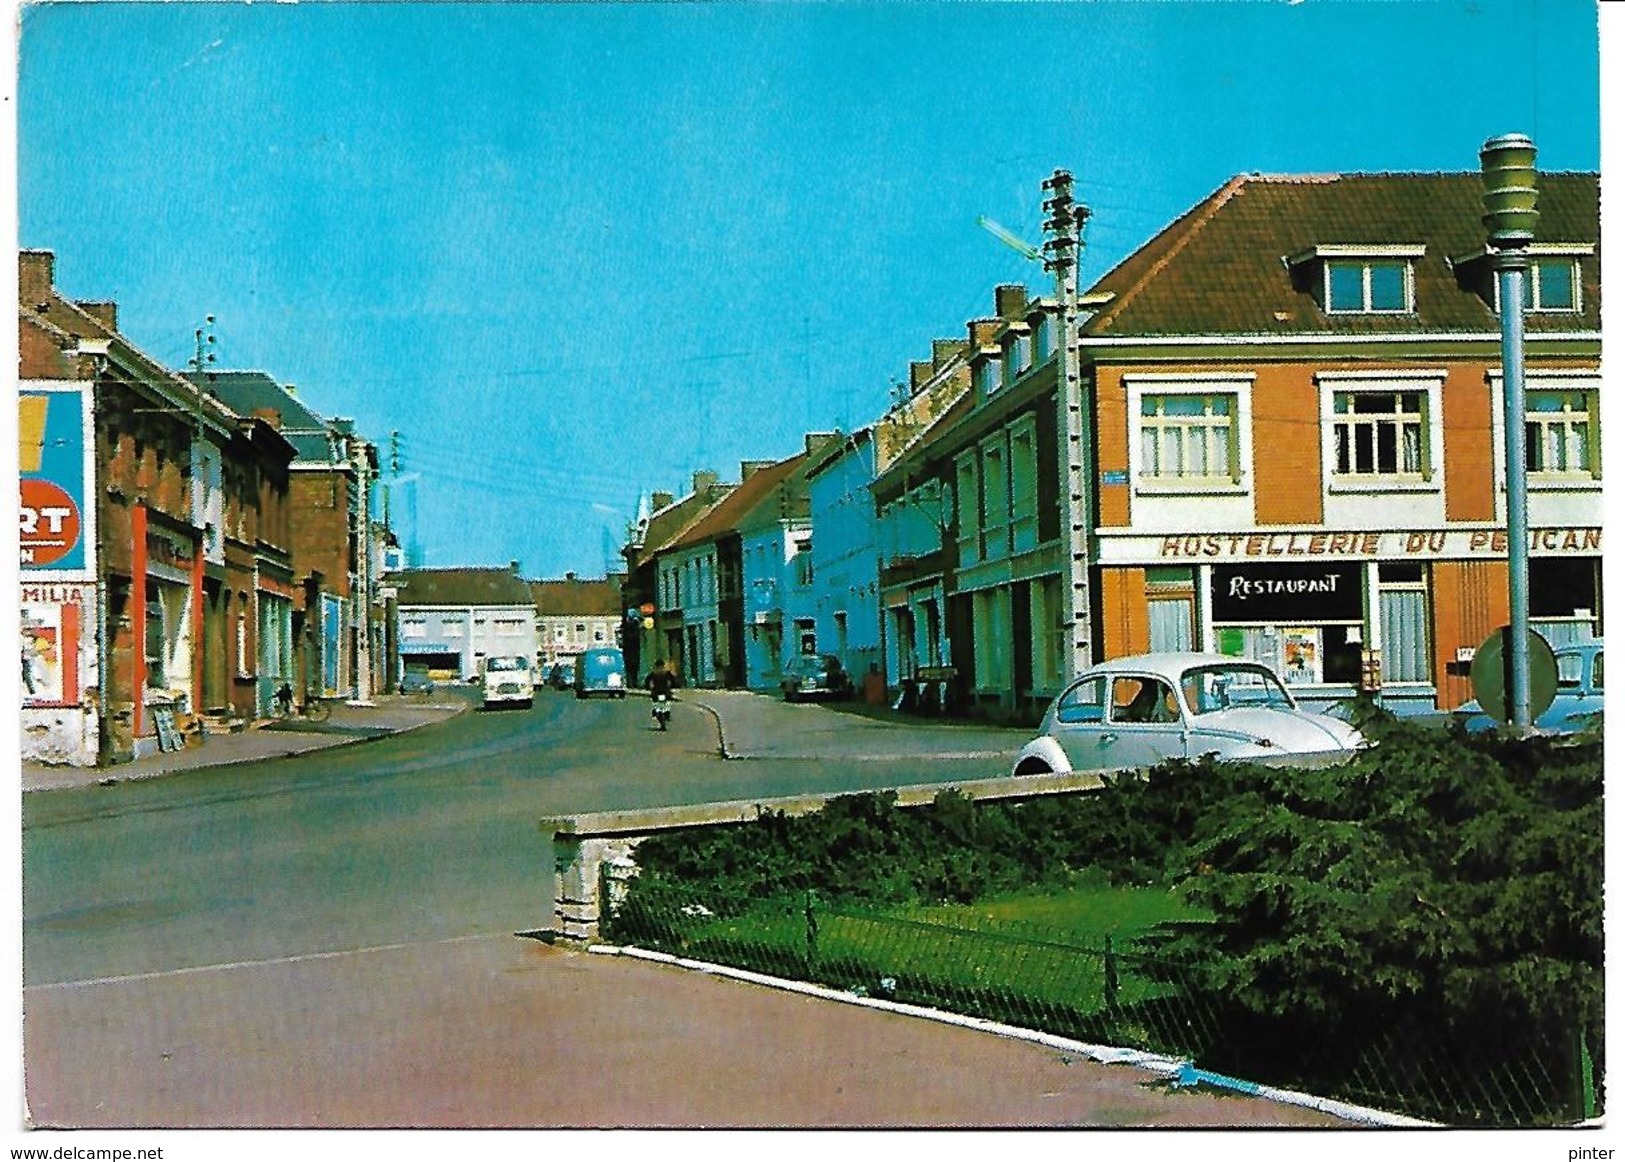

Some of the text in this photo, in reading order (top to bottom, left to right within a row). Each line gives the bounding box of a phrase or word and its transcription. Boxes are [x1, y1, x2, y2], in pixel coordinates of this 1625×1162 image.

[1161, 530, 1602, 557] HOSTELLERIE DU PEICAN
[1228, 574, 1341, 599] RESTAURANT
